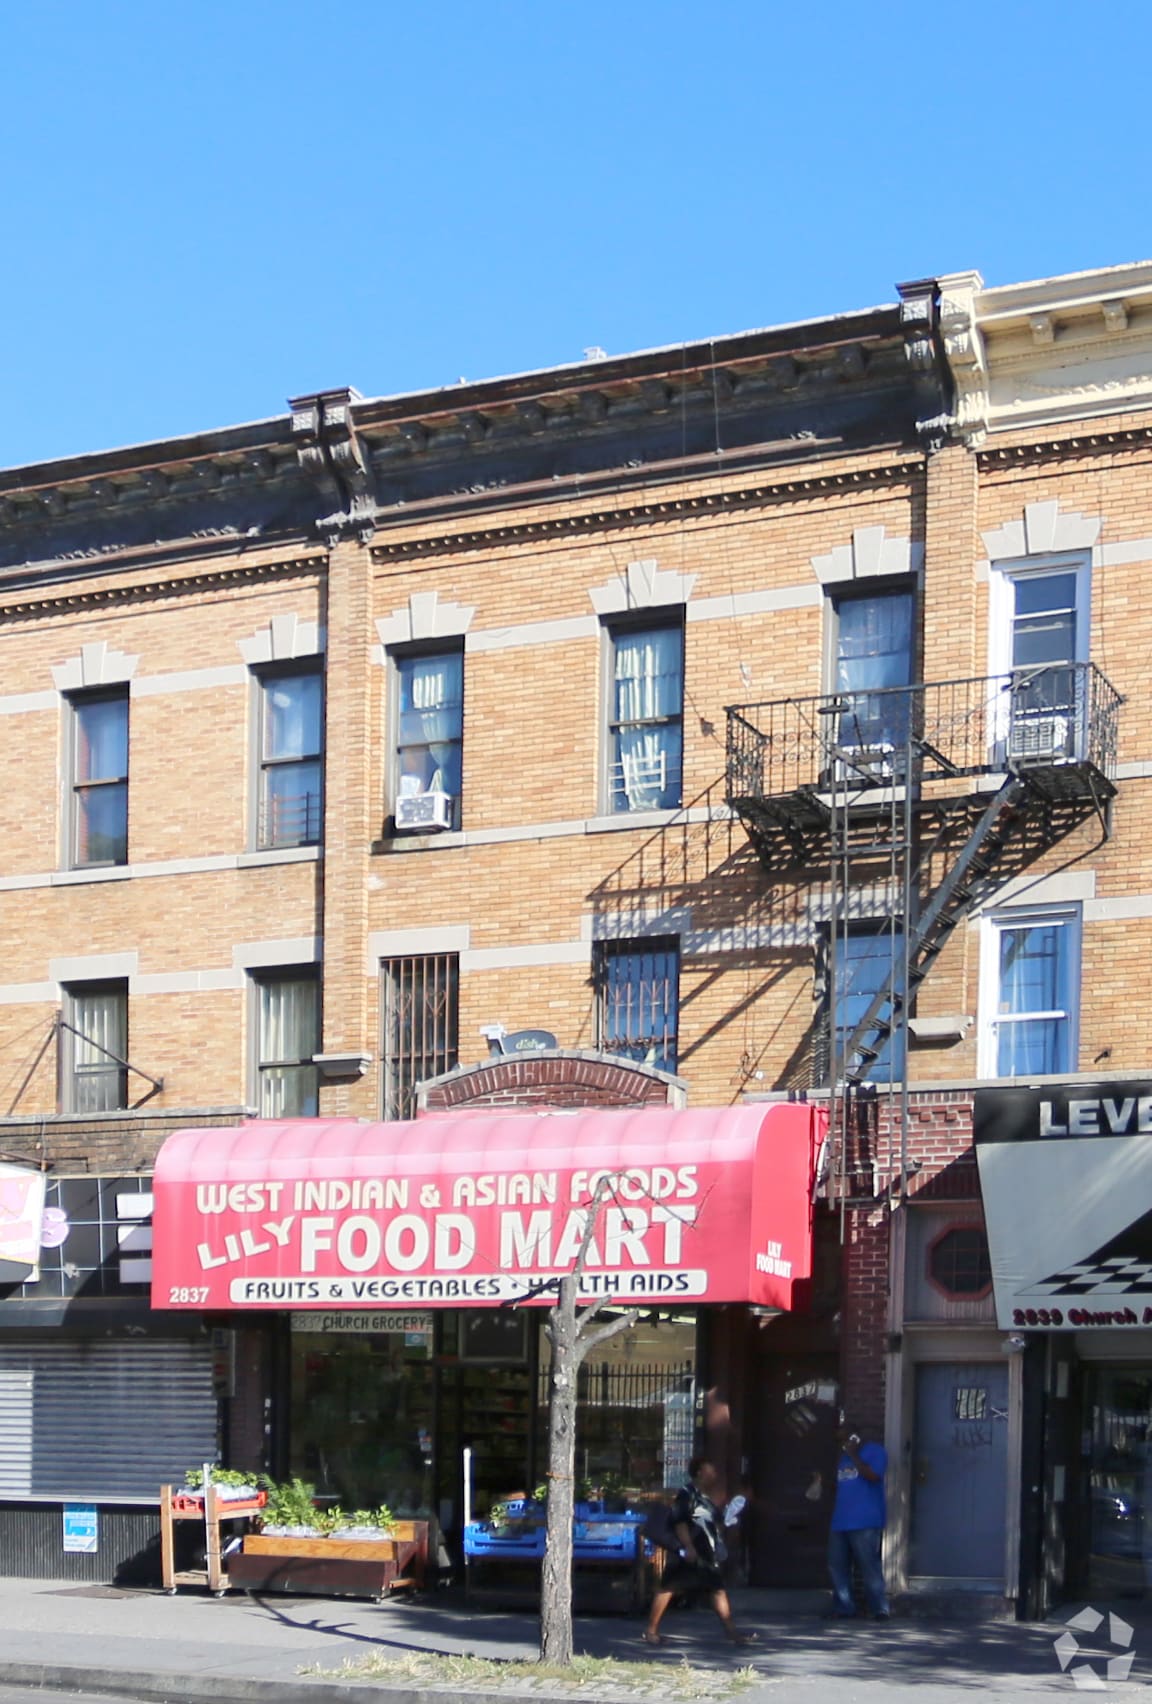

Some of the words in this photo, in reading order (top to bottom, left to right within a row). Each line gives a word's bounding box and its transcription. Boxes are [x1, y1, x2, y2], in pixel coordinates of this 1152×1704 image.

[515, 1038, 538, 1050] dish
[196, 1182, 284, 1214] WEST
[294, 1179, 408, 1211] INDIAN
[419, 1183, 441, 1209] &
[453, 1171, 557, 1207] ASIAN
[570, 1166, 698, 1203] FOODS
[196, 1215, 295, 1270] LILY
[300, 1213, 475, 1273] FOOD
[501, 1205, 697, 1269] MART
[169, 1286, 209, 1304] 2837
[245, 1281, 320, 1299] FRUITS
[329, 1284, 343, 1297] &
[352, 1278, 500, 1299] VEGETABLES
[528, 1274, 619, 1295] HELTH
[630, 1273, 689, 1292] AIDS
[322, 1316, 369, 1330] CHURCH
[372, 1315, 427, 1330] GROCERY
[1068, 1306, 1138, 1326] Church
